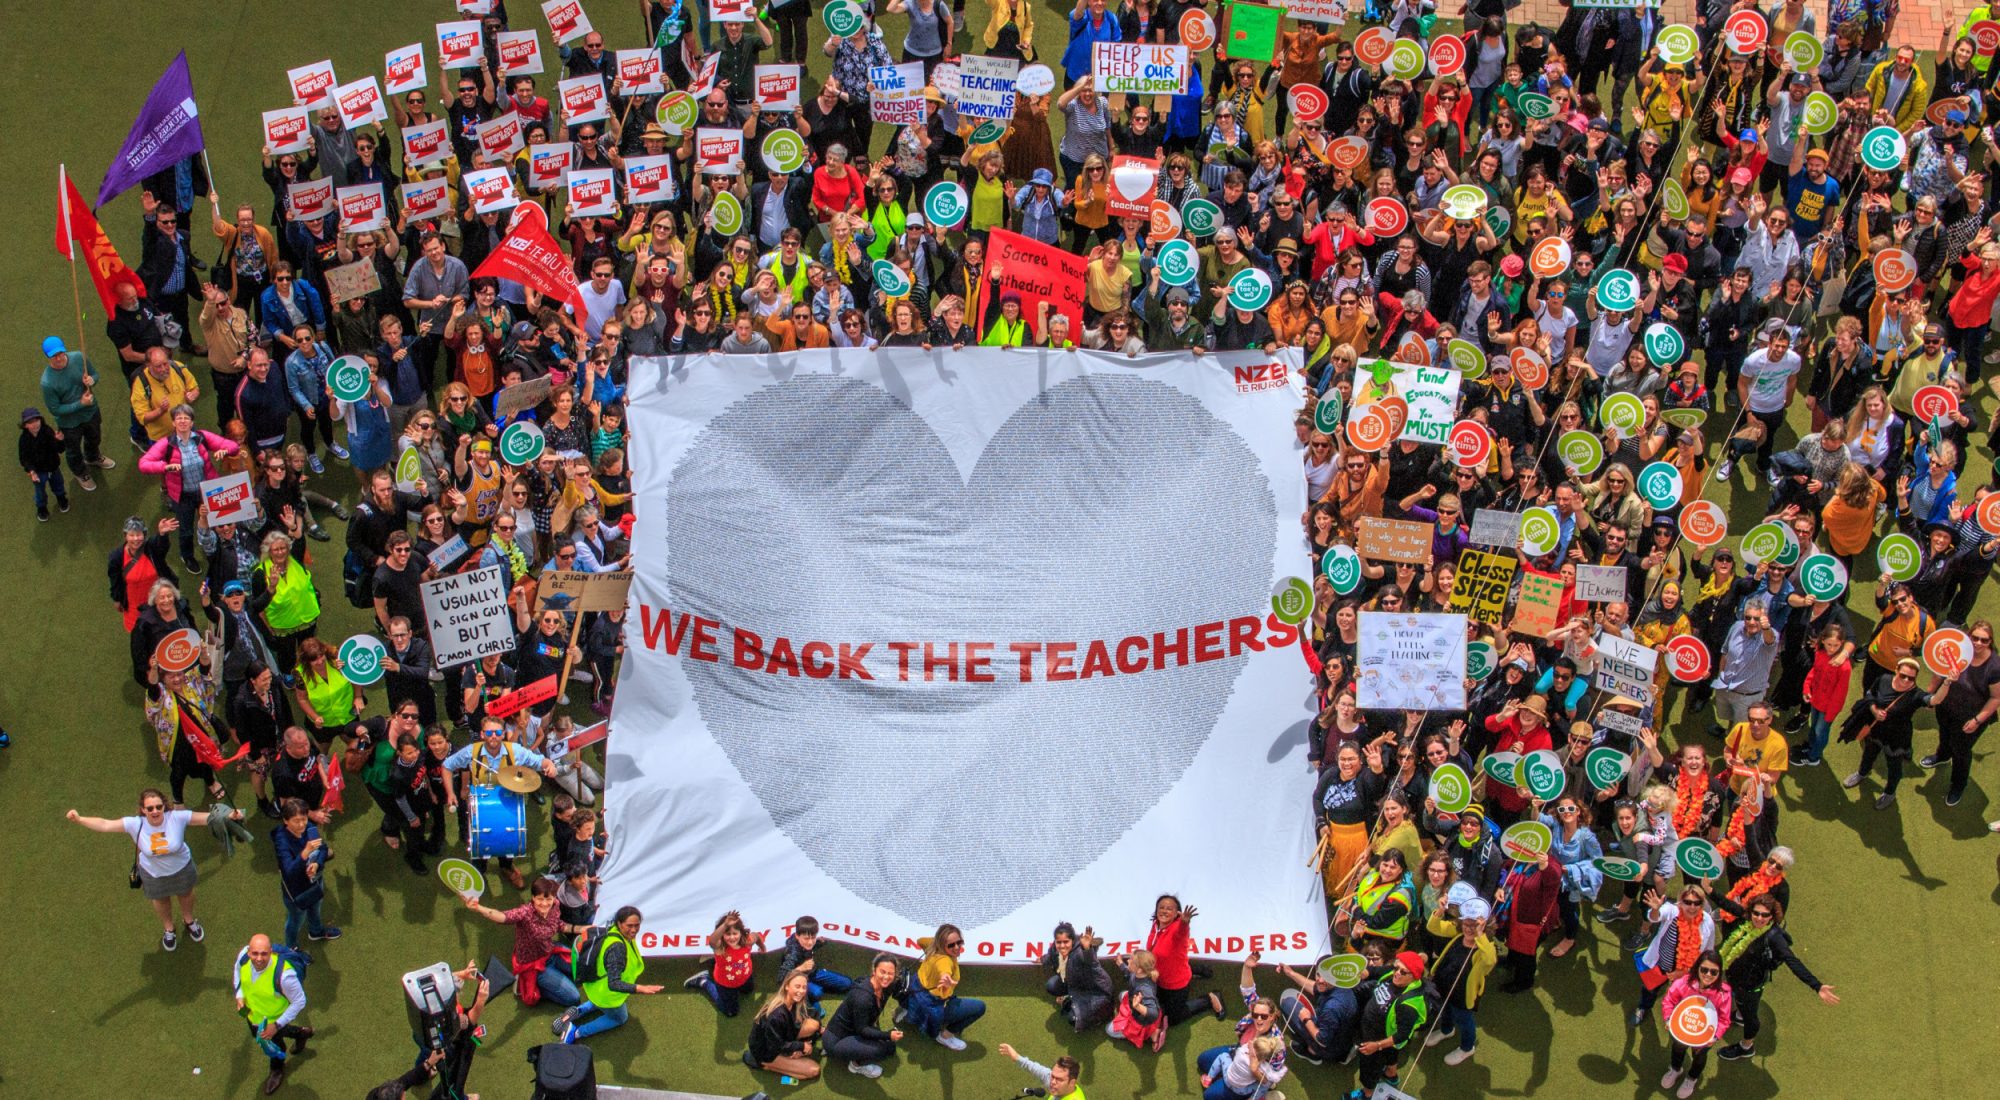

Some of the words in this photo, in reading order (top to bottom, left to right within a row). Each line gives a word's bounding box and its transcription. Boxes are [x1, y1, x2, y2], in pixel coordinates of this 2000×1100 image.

[1316, 6, 1340, 18] paid
[1736, 30, 1754, 38] time
[1668, 42, 1687, 50] time
[1098, 44, 1141, 64] HELP
[1151, 47, 1175, 66] US
[968, 66, 988, 74] rather
[986, 60, 1012, 68] would
[1100, 61, 1139, 78] HELP
[1144, 64, 1174, 79] OUR
[871, 66, 897, 80] IT'S
[1105, 65, 1184, 93] CHILDREN!
[874, 77, 906, 90] TIME
[960, 74, 1016, 92] TEACHING
[874, 98, 924, 112] OUTSIDE
[962, 92, 974, 100] but
[1001, 94, 1014, 106] IS
[874, 111, 923, 123] VOICES!
[957, 102, 1014, 118] IMPORTANT
[270, 122, 289, 133] BRING
[273, 128, 285, 137] THE
[286, 125, 301, 133] BEST
[775, 149, 793, 157] time
[1126, 160, 1146, 170] kids
[634, 168, 662, 181] PUAWAI
[1110, 200, 1149, 212] teachers
[1376, 212, 1392, 227] time
[530, 245, 544, 258] TE
[1002, 244, 1048, 266] Sacred
[1234, 363, 1288, 384] NZEI
[1417, 368, 1449, 384] Fund
[1237, 384, 1249, 393] TE
[1251, 382, 1268, 392] RIU
[1269, 378, 1290, 389] ROA
[1614, 412, 1633, 424] time
[1406, 420, 1453, 442] MUST!
[1456, 440, 1477, 450] time
[1464, 435, 1474, 444] it's
[1528, 528, 1546, 540] time
[1460, 552, 1513, 582] Class
[1607, 569, 1623, 577] MY
[1813, 567, 1827, 577] Kua
[430, 581, 459, 595] I'M
[468, 568, 499, 585] NOT
[563, 574, 588, 582] SIGN
[592, 573, 603, 581] IT
[607, 573, 633, 581] MUST
[440, 587, 499, 611] USUALLY
[434, 619, 442, 630] A
[450, 611, 479, 624] SIGN
[483, 604, 507, 618] GUY
[458, 622, 491, 642] BUT
[640, 604, 721, 662] WE
[733, 626, 876, 681] BACK
[888, 642, 995, 682] THE
[1010, 612, 1299, 682] TEACHERS
[437, 650, 472, 665] C'MON
[477, 637, 514, 653] CHRIS
[1615, 640, 1640, 663] WE
[1604, 657, 1648, 681] NEED
[1599, 672, 1647, 702] TEACHERS
[1439, 784, 1457, 798] time
[978, 942, 1014, 956] OF
[1685, 1009, 1699, 1019] Kua
